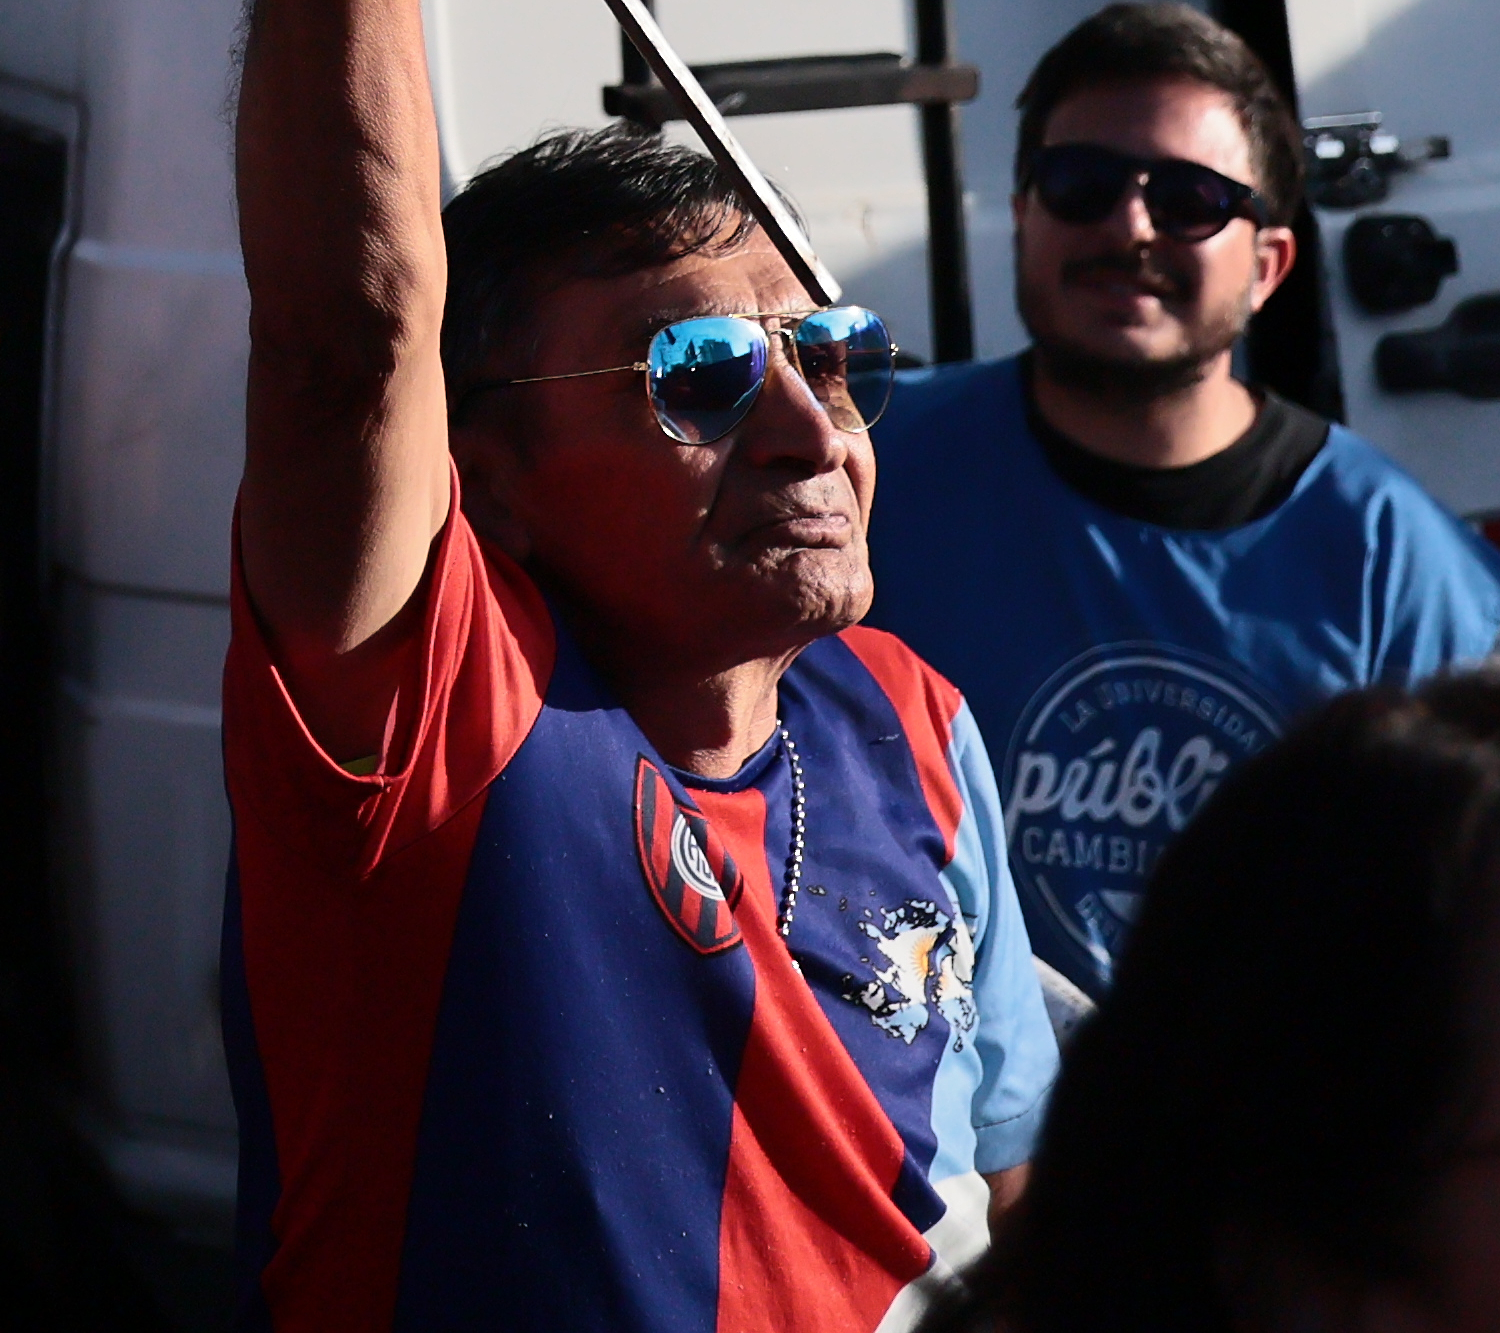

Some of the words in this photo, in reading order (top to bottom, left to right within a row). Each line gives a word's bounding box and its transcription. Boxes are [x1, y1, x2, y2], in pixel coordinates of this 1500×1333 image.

[1058, 702, 1097, 734] LA
[1095, 679, 1267, 755] UNIVERSIDA
[1021, 826, 1167, 877] CAMBI
